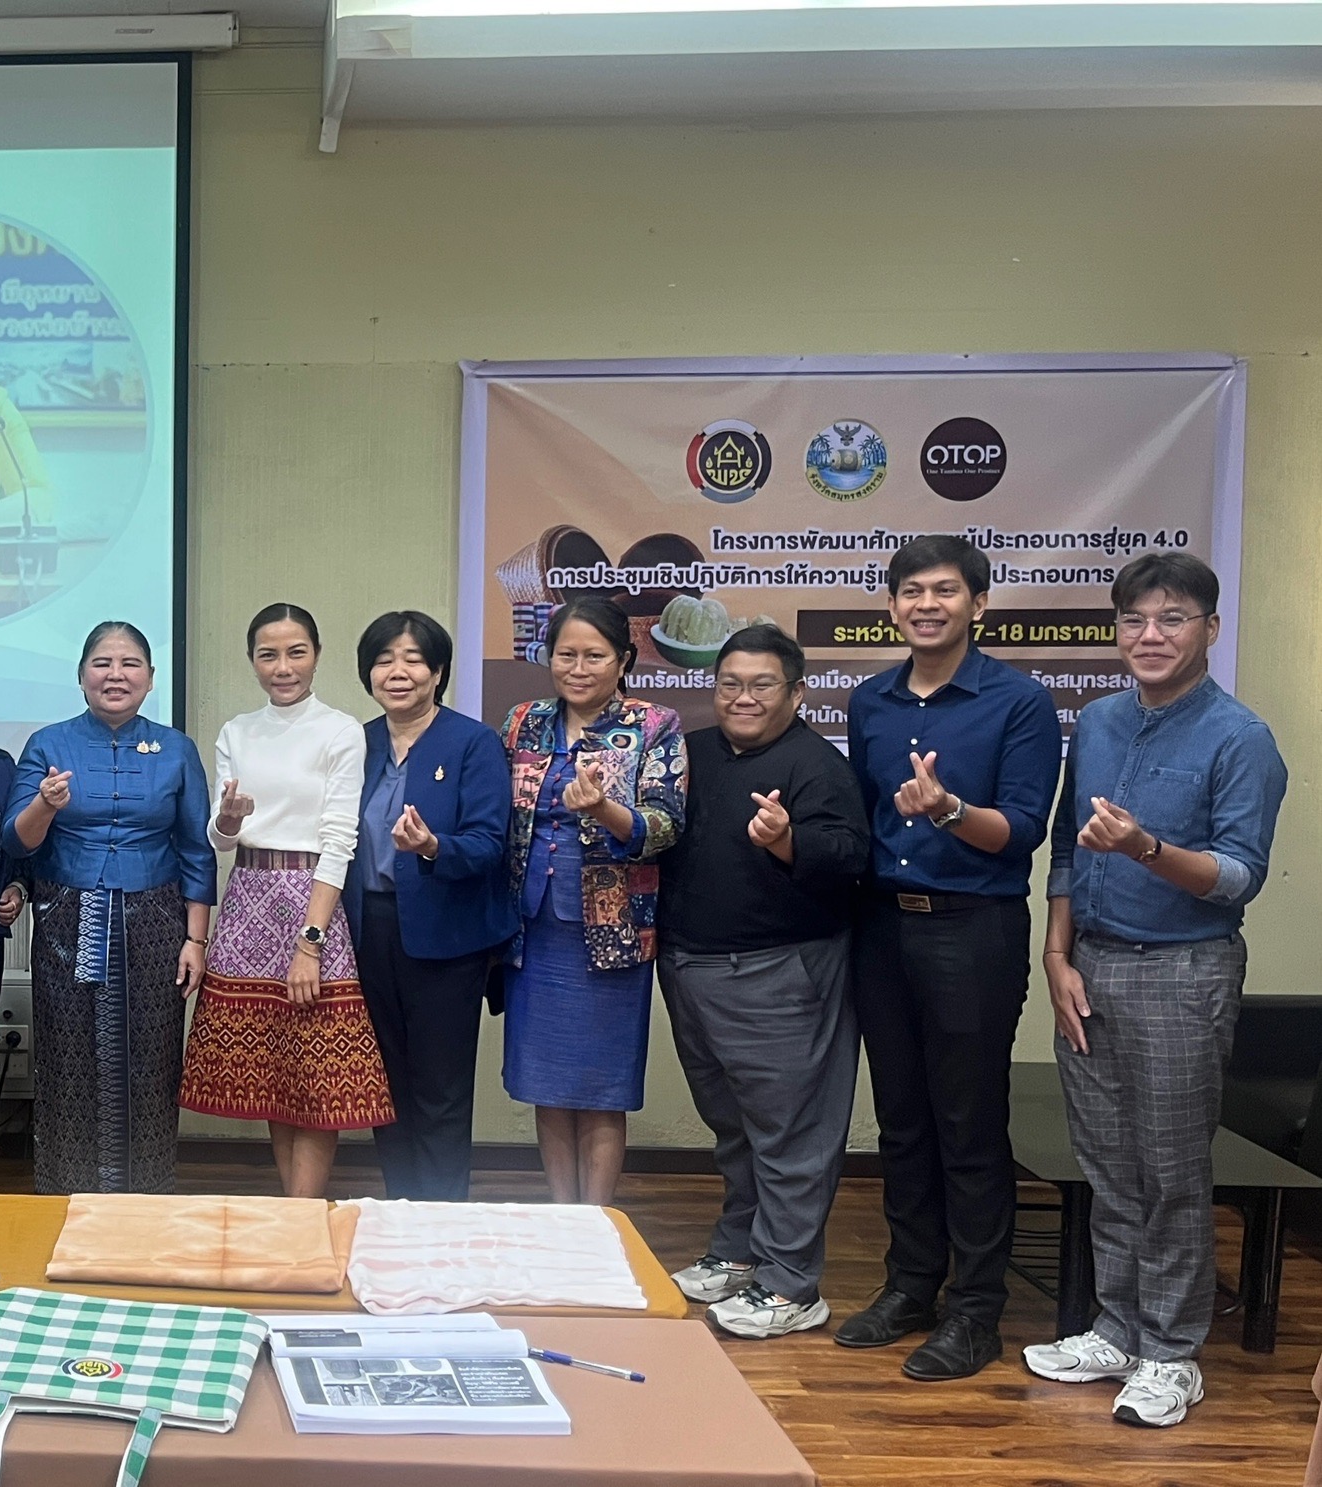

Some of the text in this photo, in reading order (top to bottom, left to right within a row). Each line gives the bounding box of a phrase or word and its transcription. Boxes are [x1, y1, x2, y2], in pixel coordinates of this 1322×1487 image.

[926, 445, 1001, 464] OTOP
[1153, 530, 1188, 547] 4.0
[550, 563, 1115, 591] การประชุมเชิงปฏิบัติการให้ความรู้แ ประกอบการ
[973, 624, 1024, 642] 7-18
[1029, 624, 1115, 642] มกราคม
